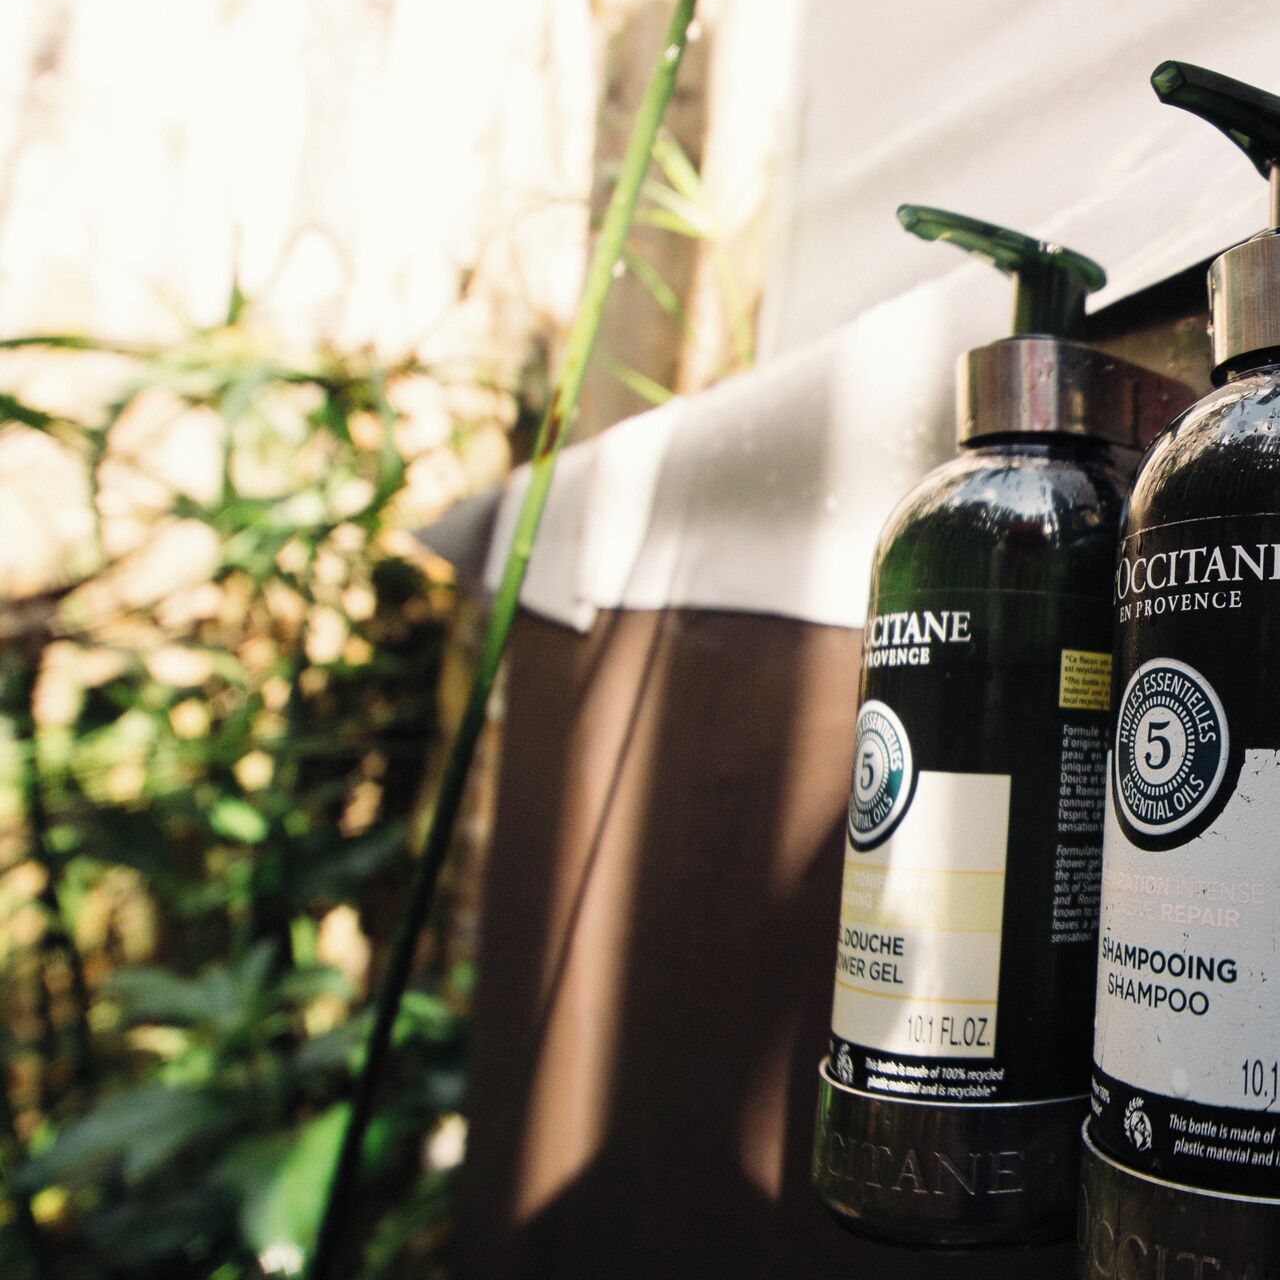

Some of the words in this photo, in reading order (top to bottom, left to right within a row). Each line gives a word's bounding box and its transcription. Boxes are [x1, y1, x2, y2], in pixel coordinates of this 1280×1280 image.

[1119, 604, 1132, 624] EN
[1135, 590, 1243, 617] PROVENCE
[1121, 684, 1143, 743] HUILES
[1143, 672, 1217, 743] ESSENTIELLES
[1145, 720, 1171, 769] 5
[860, 751, 873, 790] 5
[873, 793, 893, 823] OILS
[1122, 773, 1174, 820] ESSENTIAL
[1173, 773, 1204, 811] OILS
[845, 927, 905, 957] DOUCHE
[869, 960, 904, 984] GEL
[1102, 936, 1237, 983] SHAMPOOING
[1107, 972, 1209, 1015] SHAMPOO
[908, 1014, 934, 1045] 10.1
[940, 1016, 990, 1047] FL.OZ.
[930, 1065, 941, 1079] of
[942, 1066, 966, 1081] 100%
[967, 1067, 1004, 1083] recycled
[1242, 1059, 1278, 1099] 10.1
[1169, 1113, 1187, 1132] This
[1188, 1118, 1217, 1138] bottle
[1219, 1123, 1228, 1139] is
[1229, 1125, 1261, 1144] made
[1263, 1127, 1277, 1145] of
[1173, 1137, 1204, 1156] plastic
[1206, 1144, 1251, 1165] material
[1251, 1149, 1274, 1167] and
